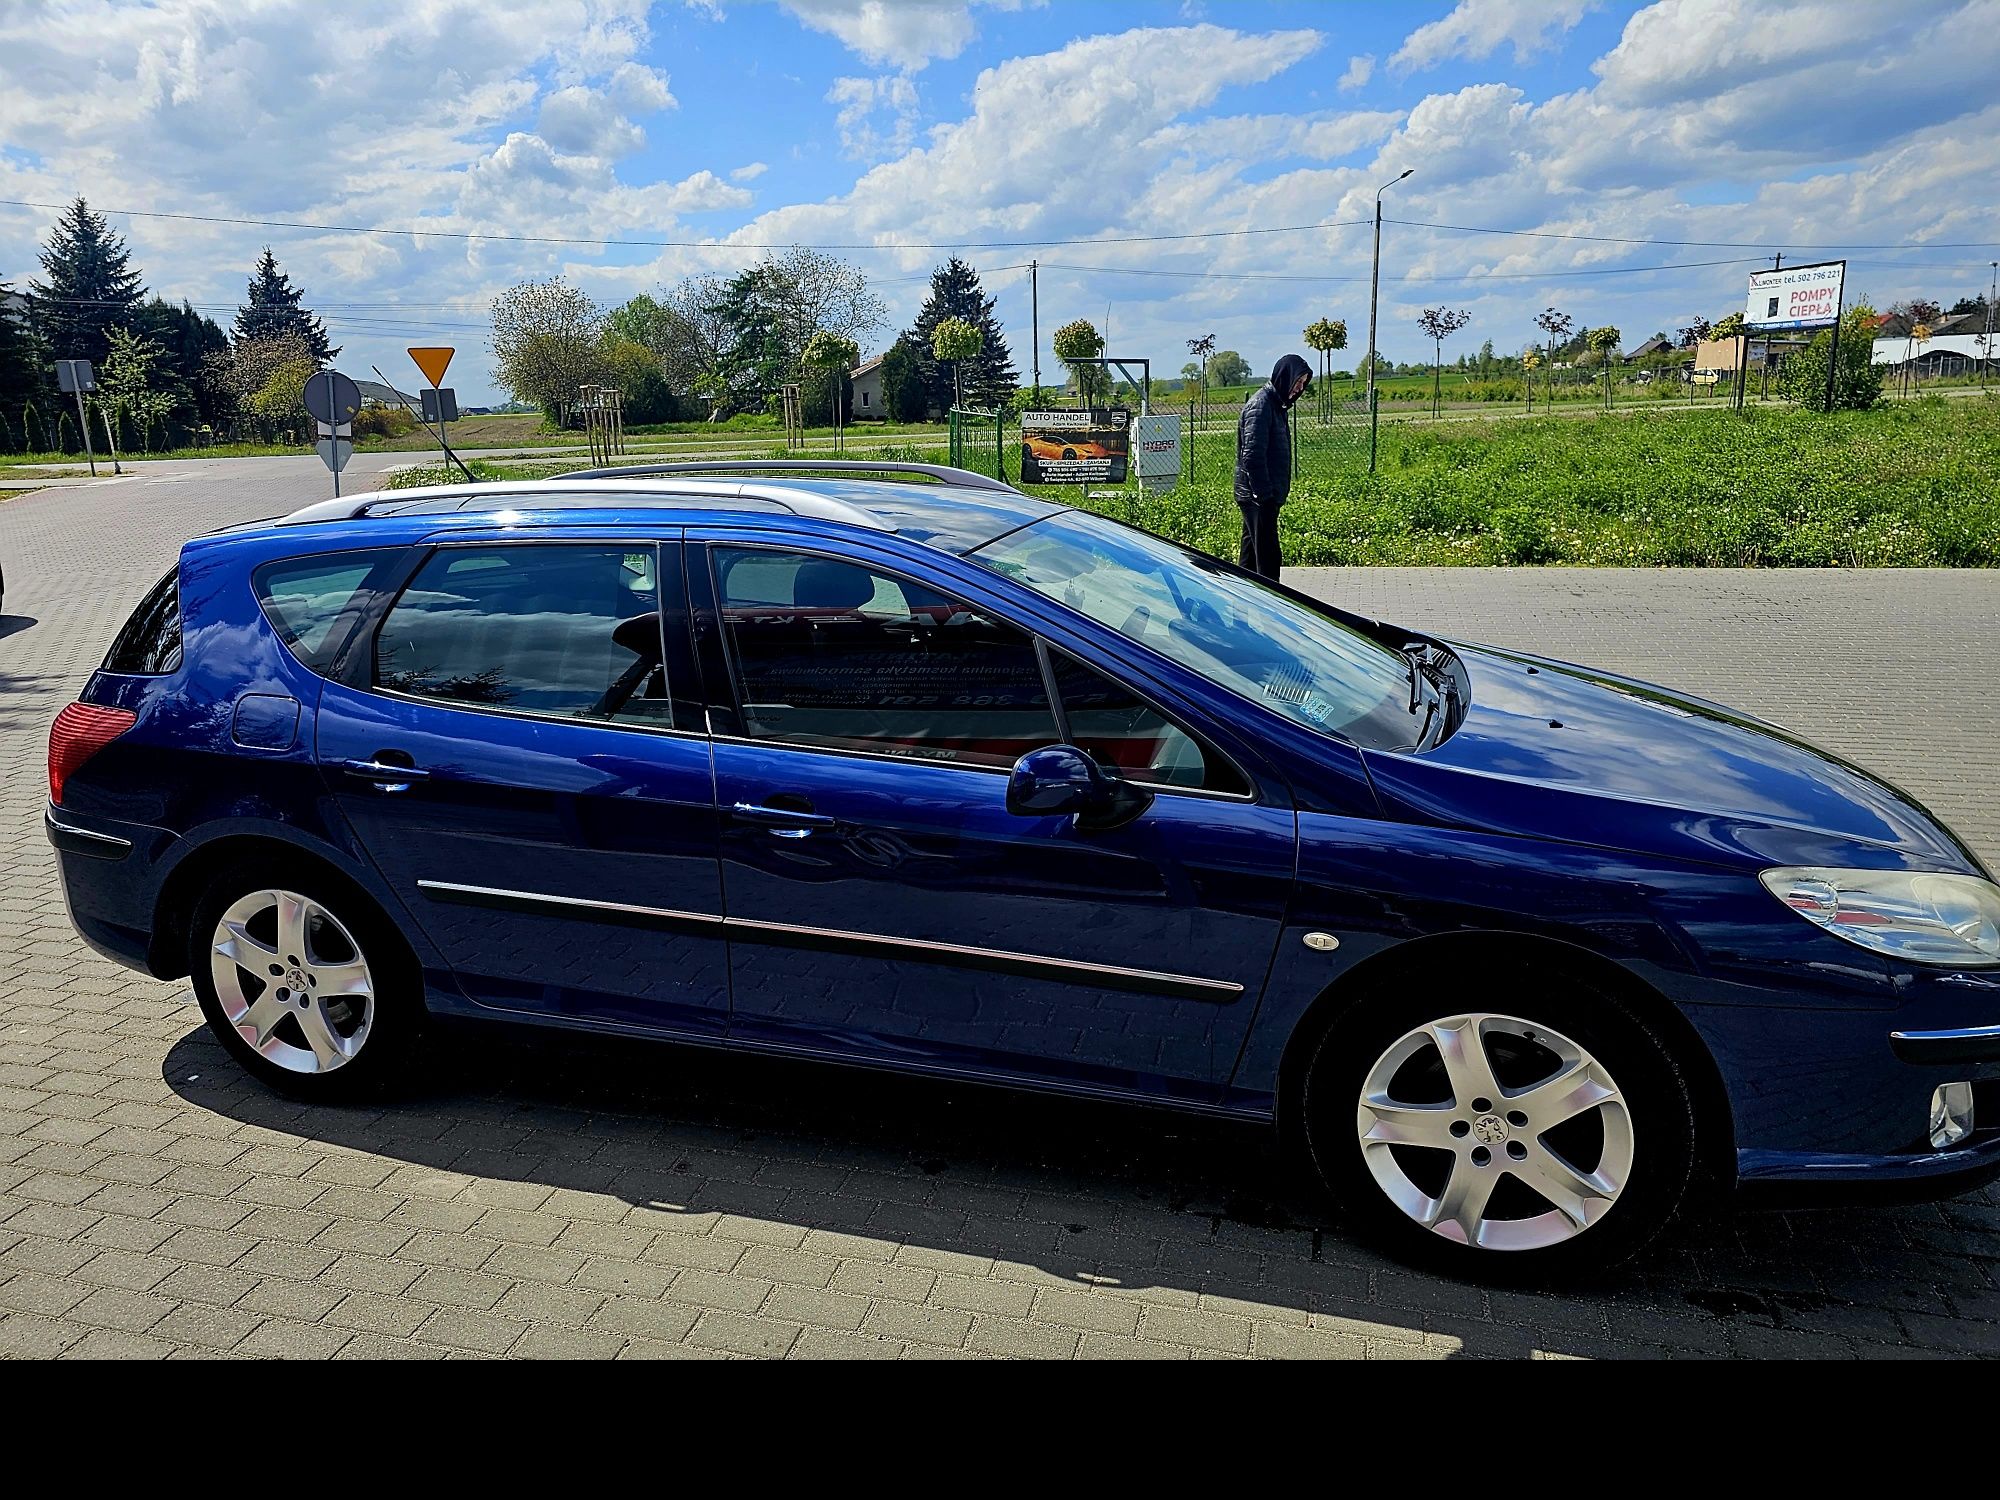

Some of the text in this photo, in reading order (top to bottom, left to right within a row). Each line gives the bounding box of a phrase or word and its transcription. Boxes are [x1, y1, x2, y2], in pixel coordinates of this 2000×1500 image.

[1797, 274, 1811, 283] 502
[1812, 272, 1826, 281] 796
[1827, 270, 1840, 279] 221
[1790, 287, 1836, 303] POMPY
[1789, 303, 1832, 317] CIEPŁA
[1025, 413, 1090, 421] AUTO HANDEL
[1142, 439, 1175, 447] HYDRO
